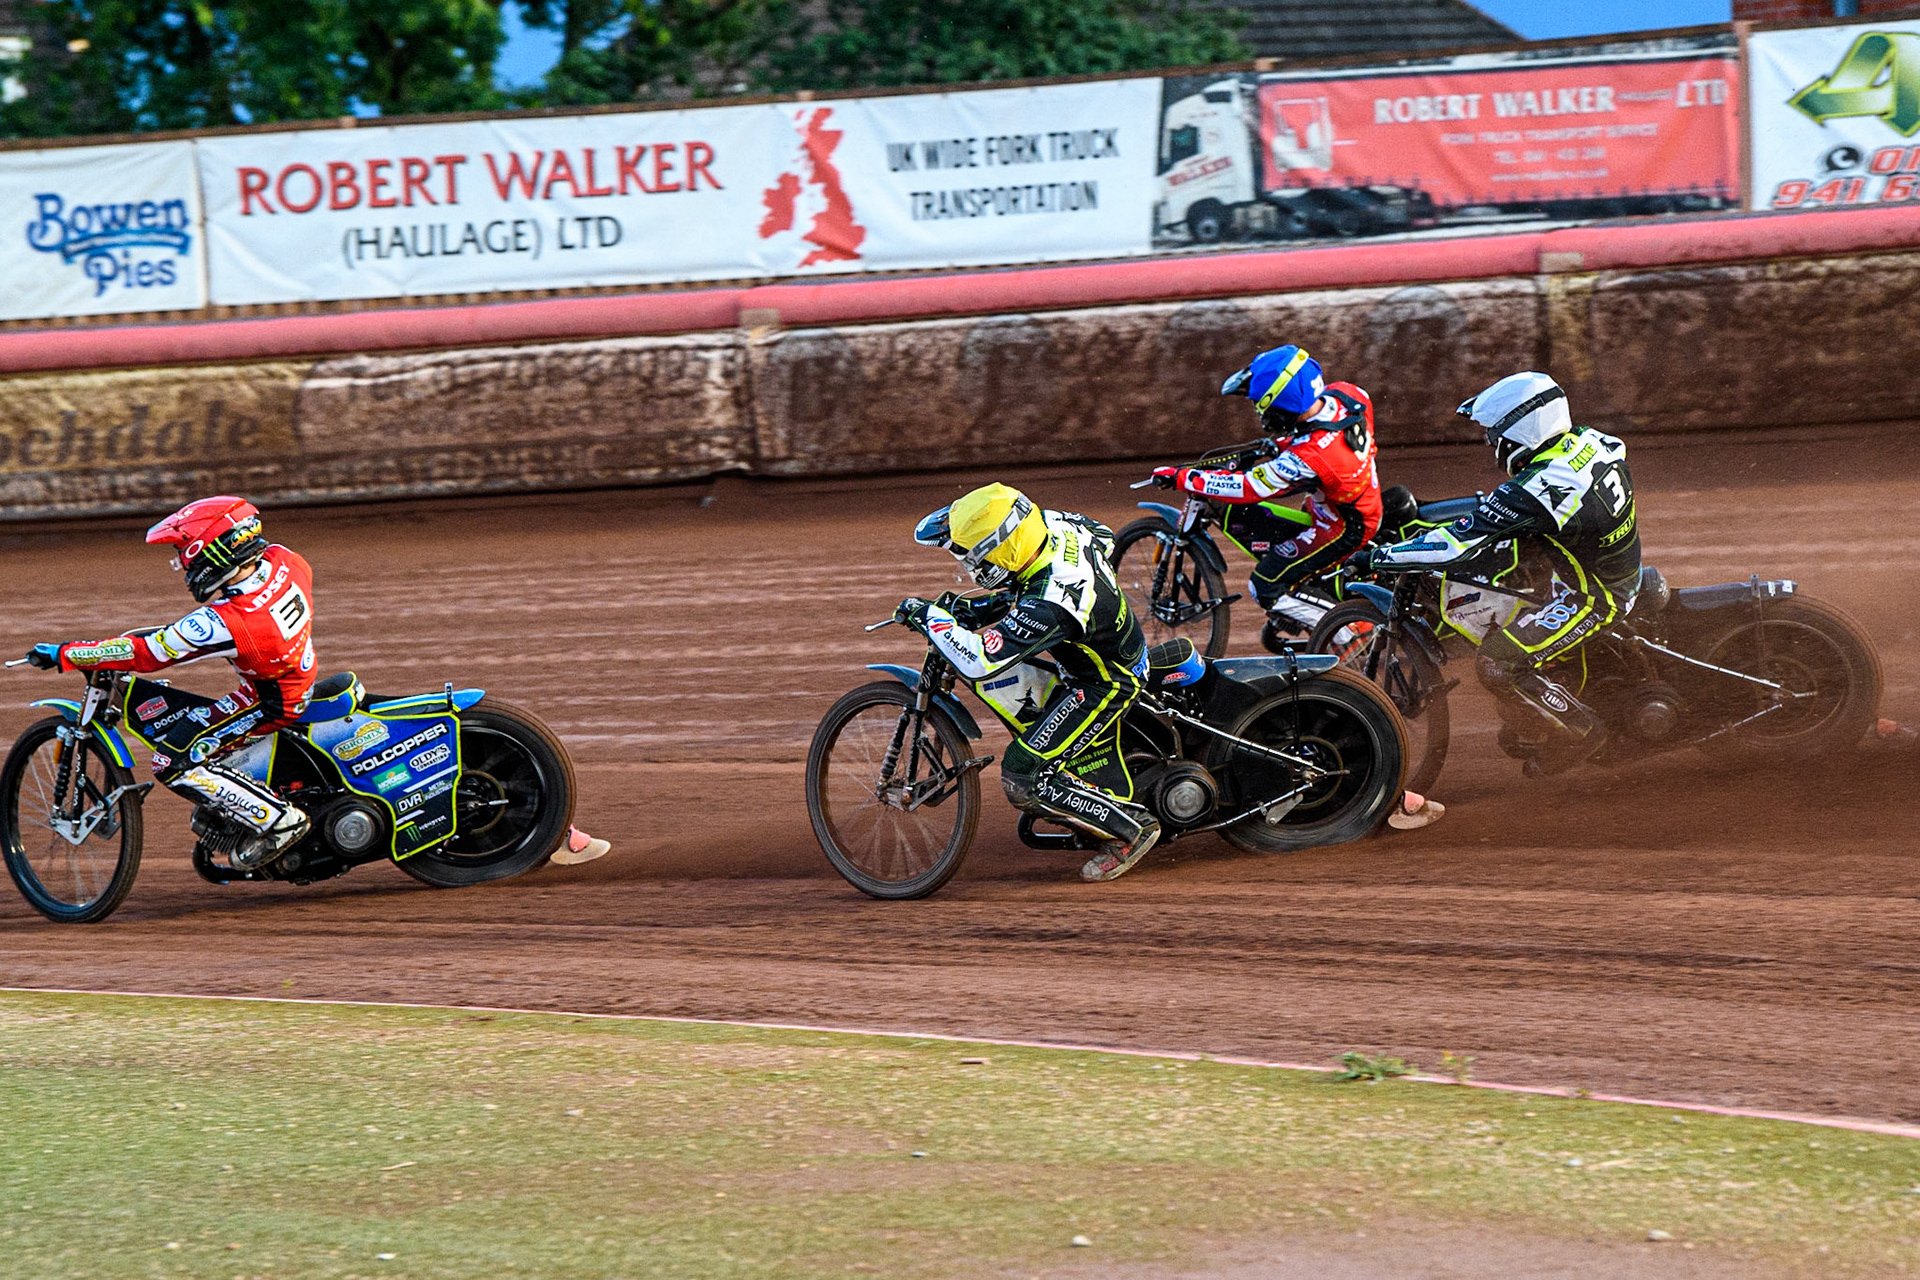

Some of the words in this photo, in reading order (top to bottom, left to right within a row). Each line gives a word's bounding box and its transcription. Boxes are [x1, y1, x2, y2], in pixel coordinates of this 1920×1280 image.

[1374, 93, 1482, 125] ROBERT
[1492, 86, 1616, 118] WALKER
[886, 141, 917, 172] UK
[921, 137, 978, 170] WIDE
[986, 133, 1044, 167] FORK
[1047, 127, 1122, 162] TRUCK
[236, 154, 467, 216] ROBERT
[482, 141, 726, 202] WALKER
[1772, 177, 1867, 208] 941
[909, 180, 1100, 222] TRANSPORTATION
[26, 193, 190, 252] Bowen
[342, 218, 543, 270] (HAULAGE)
[557, 215, 623, 250] LTD
[85, 252, 177, 297] Pies
[1568, 443, 1597, 473] KING
[1603, 470, 1626, 514] 3
[1489, 496, 1520, 520] Euston
[1064, 530, 1080, 568] HUME
[186, 618, 207, 637] ATPI
[279, 594, 306, 630] 3
[1016, 611, 1050, 633] Euston
[69, 644, 129, 660] AGROMIX
[951, 637, 978, 663] HUME
[153, 706, 190, 730] DOCUFY
[337, 728, 383, 753] AGROMIX
[351, 722, 449, 776] POLCOPPER
[411, 743, 449, 768] OLDY'S
[1062, 722, 1103, 759] Centre
[1076, 757, 1110, 776] Restore
[398, 792, 423, 812] DVR
[1062, 792, 1111, 822] Bentley
